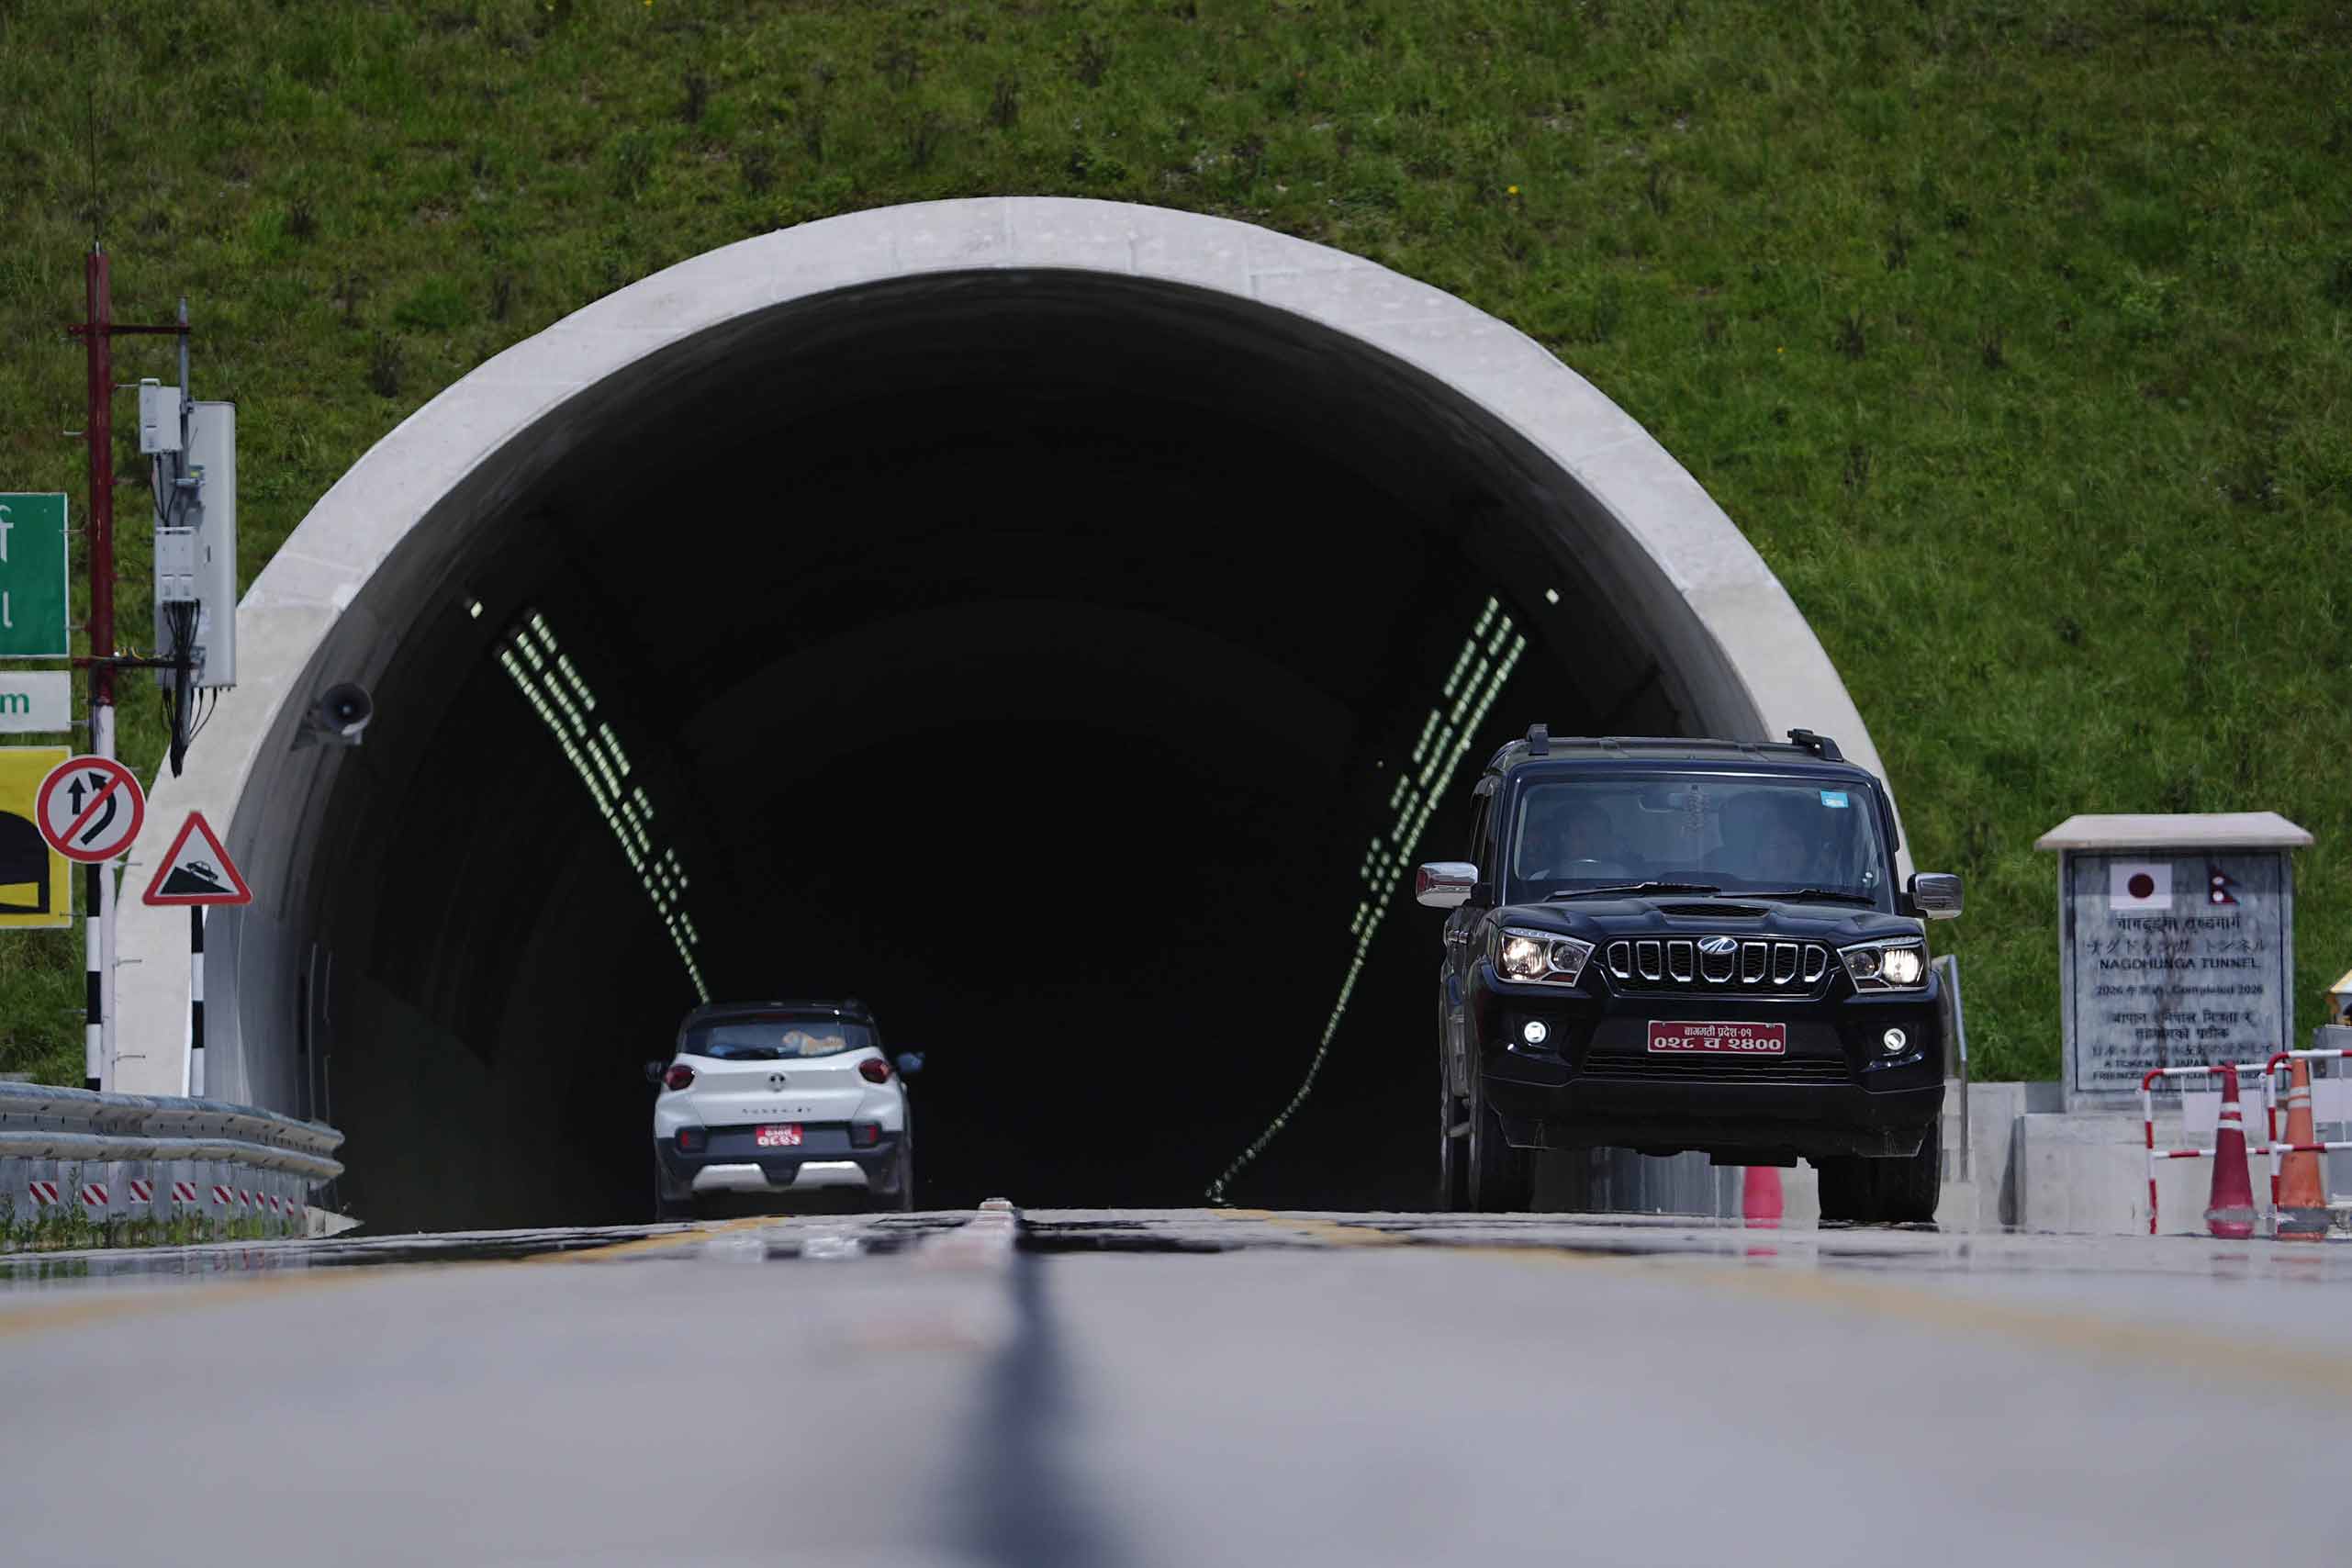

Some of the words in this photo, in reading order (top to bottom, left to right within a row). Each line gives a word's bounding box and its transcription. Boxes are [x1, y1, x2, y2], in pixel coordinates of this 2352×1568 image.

[2100, 958, 2196, 969] NAGDHUNGA
[2201, 958, 2262, 969] TUNNEL
[1728, 1038, 1782, 1050] २४००
